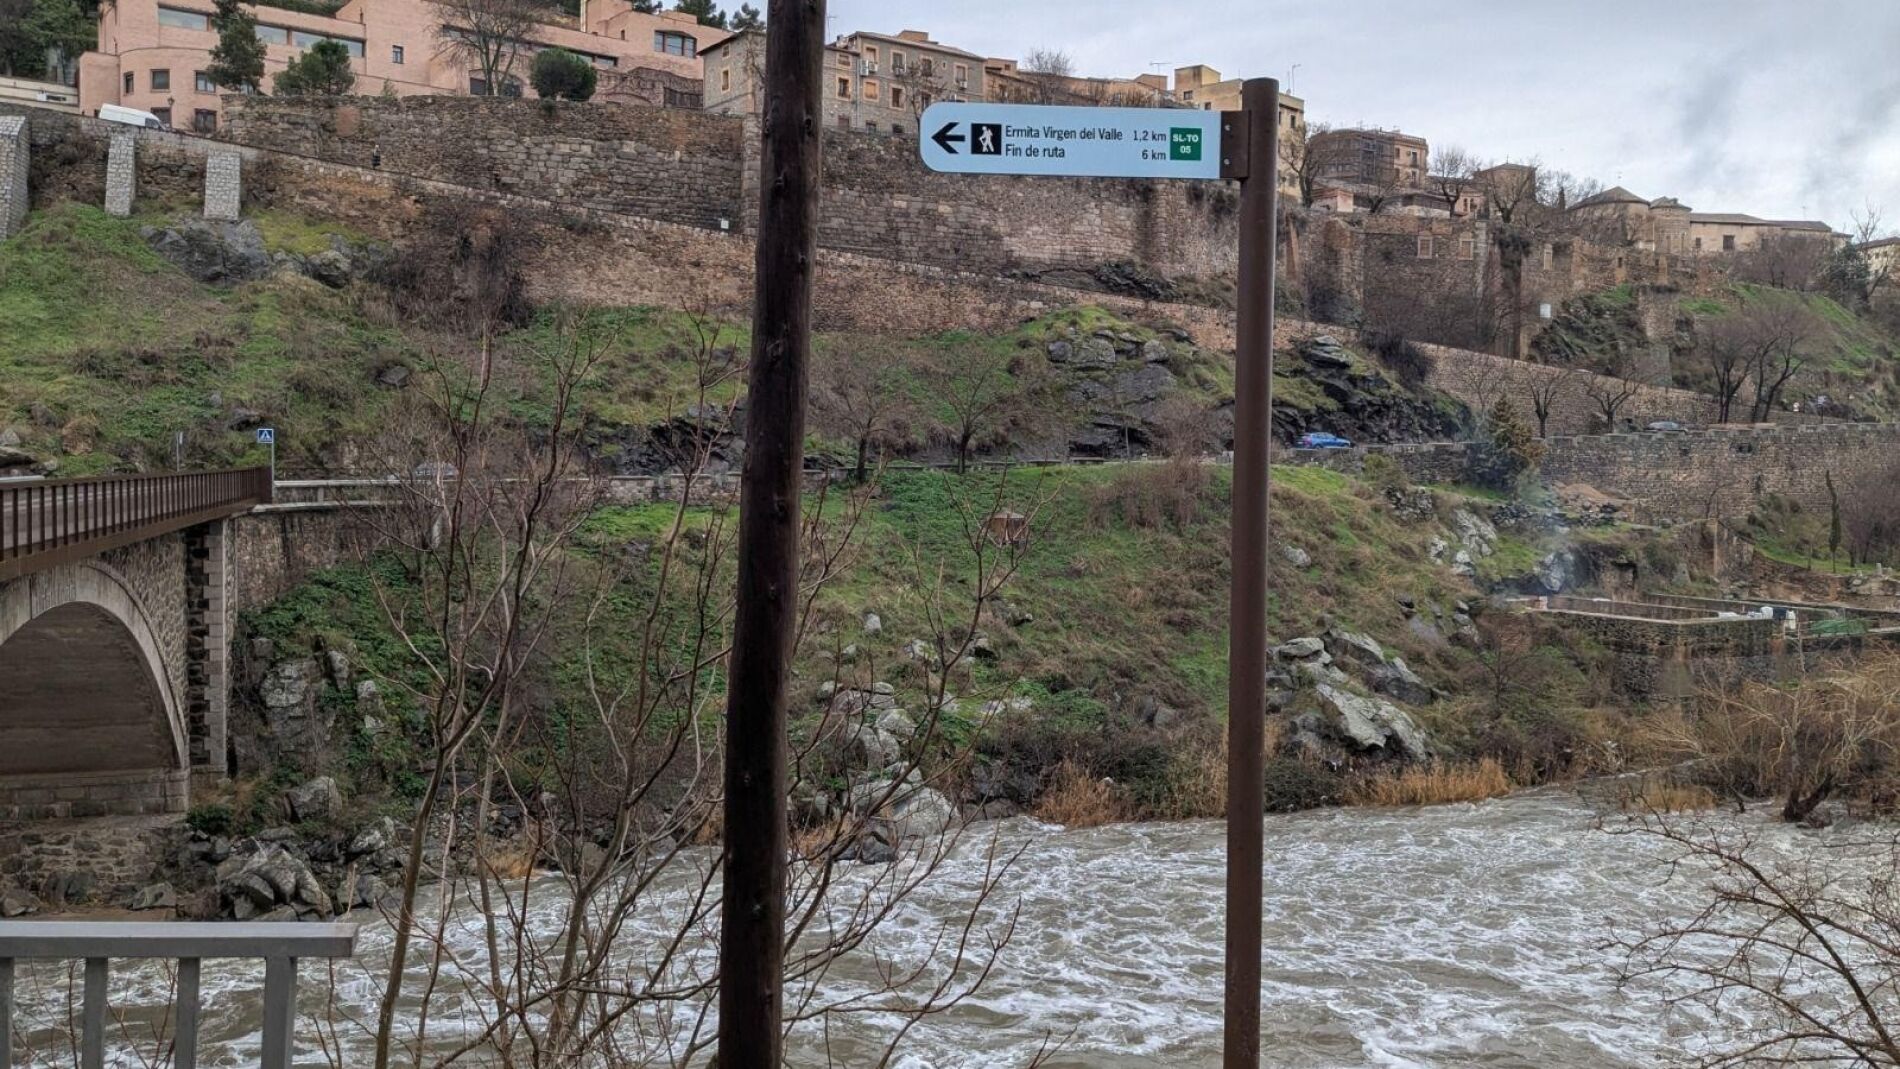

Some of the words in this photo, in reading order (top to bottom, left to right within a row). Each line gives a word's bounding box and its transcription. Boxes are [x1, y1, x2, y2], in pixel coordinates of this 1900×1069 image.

[1005, 125, 1040, 139] Ermita
[1043, 126, 1077, 141] Virgen
[1079, 127, 1096, 140] del
[1098, 127, 1123, 140] Valle
[1133, 130, 1149, 142] 1,2
[1151, 130, 1167, 142] km
[1172, 133, 1199, 143] SL-TO
[1005, 143, 1022, 157] Fin
[1025, 144, 1040, 158] de
[1042, 146, 1065, 158] ruta
[1141, 149, 1149, 160] 6
[1151, 149, 1167, 160] km
[1179, 145, 1192, 154] 05
